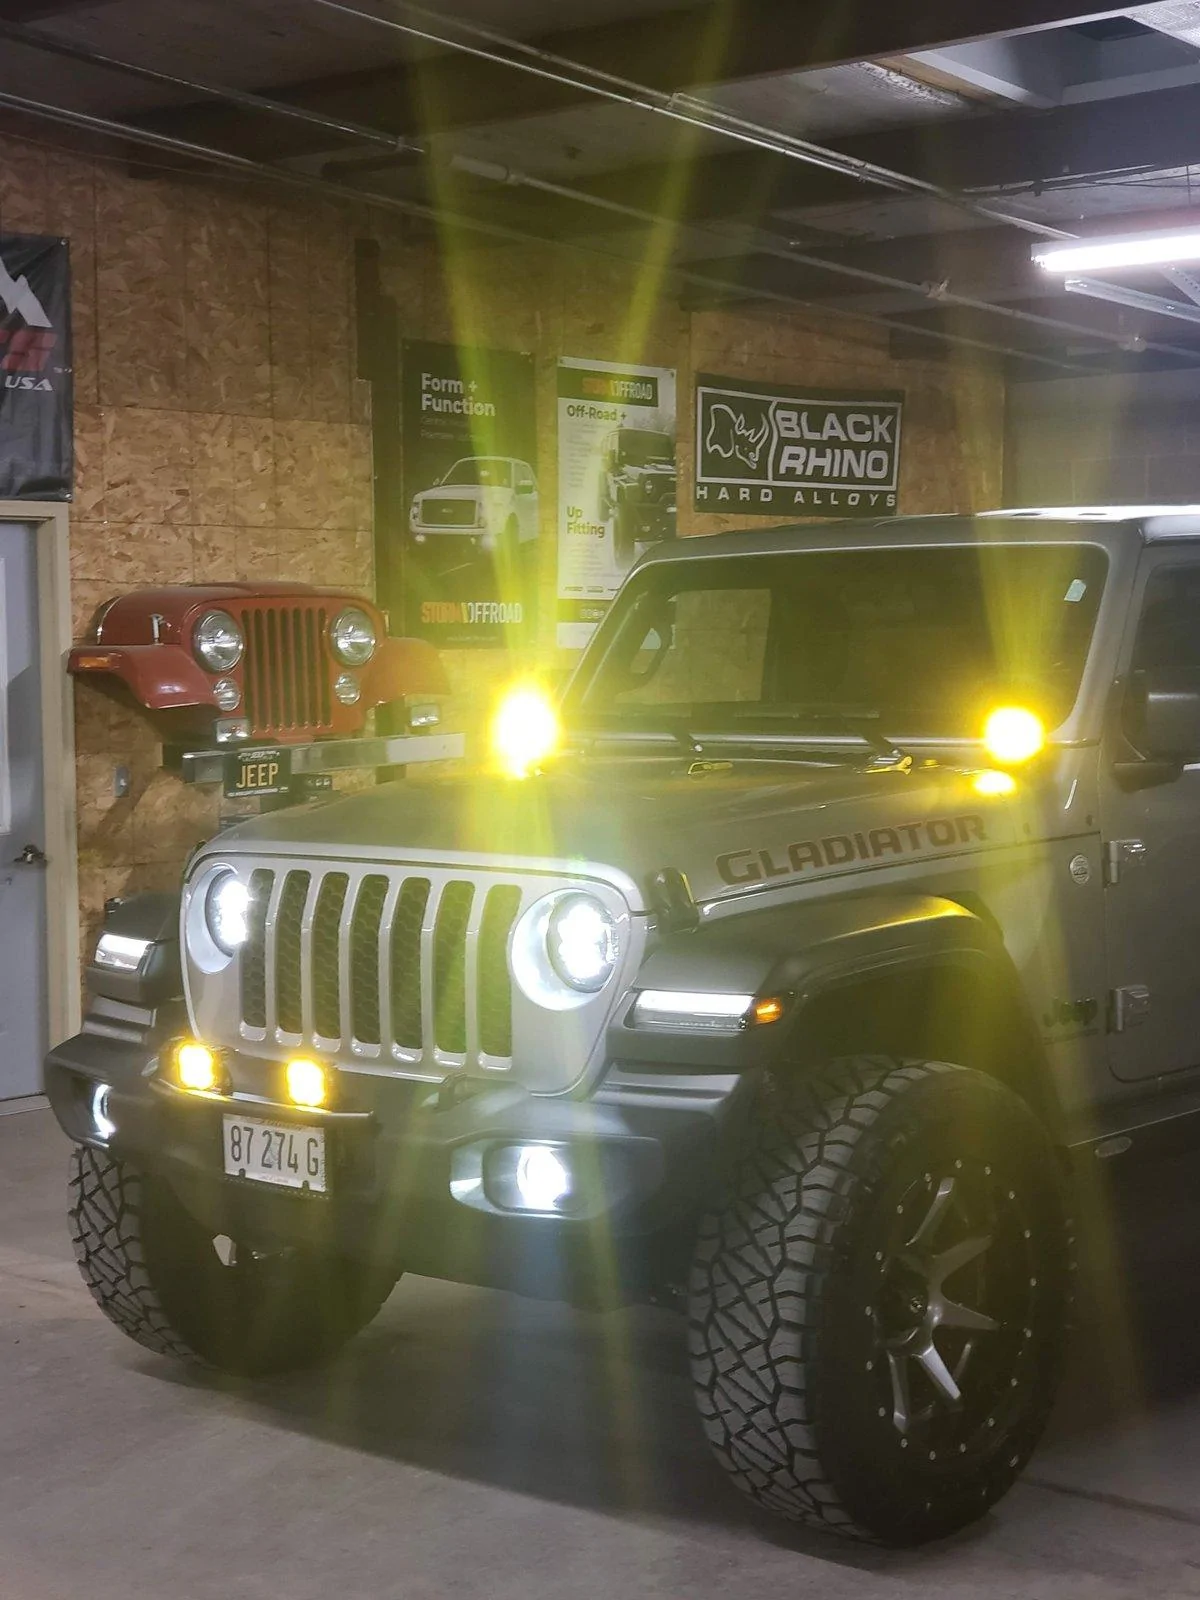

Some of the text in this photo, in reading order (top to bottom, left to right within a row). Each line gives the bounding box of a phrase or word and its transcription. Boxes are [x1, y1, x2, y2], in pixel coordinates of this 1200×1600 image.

[4, 375, 53, 391] USA
[421, 372, 464, 394] Form
[421, 393, 496, 417] Function
[566, 404, 618, 421] Off-Road
[775, 409, 894, 443] BLACK
[778, 445, 889, 479] RHINO
[696, 486, 897, 507] HARD ALLOYS
[566, 505, 583, 521] Up
[566, 522, 605, 539] Fitting
[236, 762, 279, 789] JEEP
[714, 814, 991, 886] GLADIATOR
[230, 1125, 319, 1176] 87 274 G
